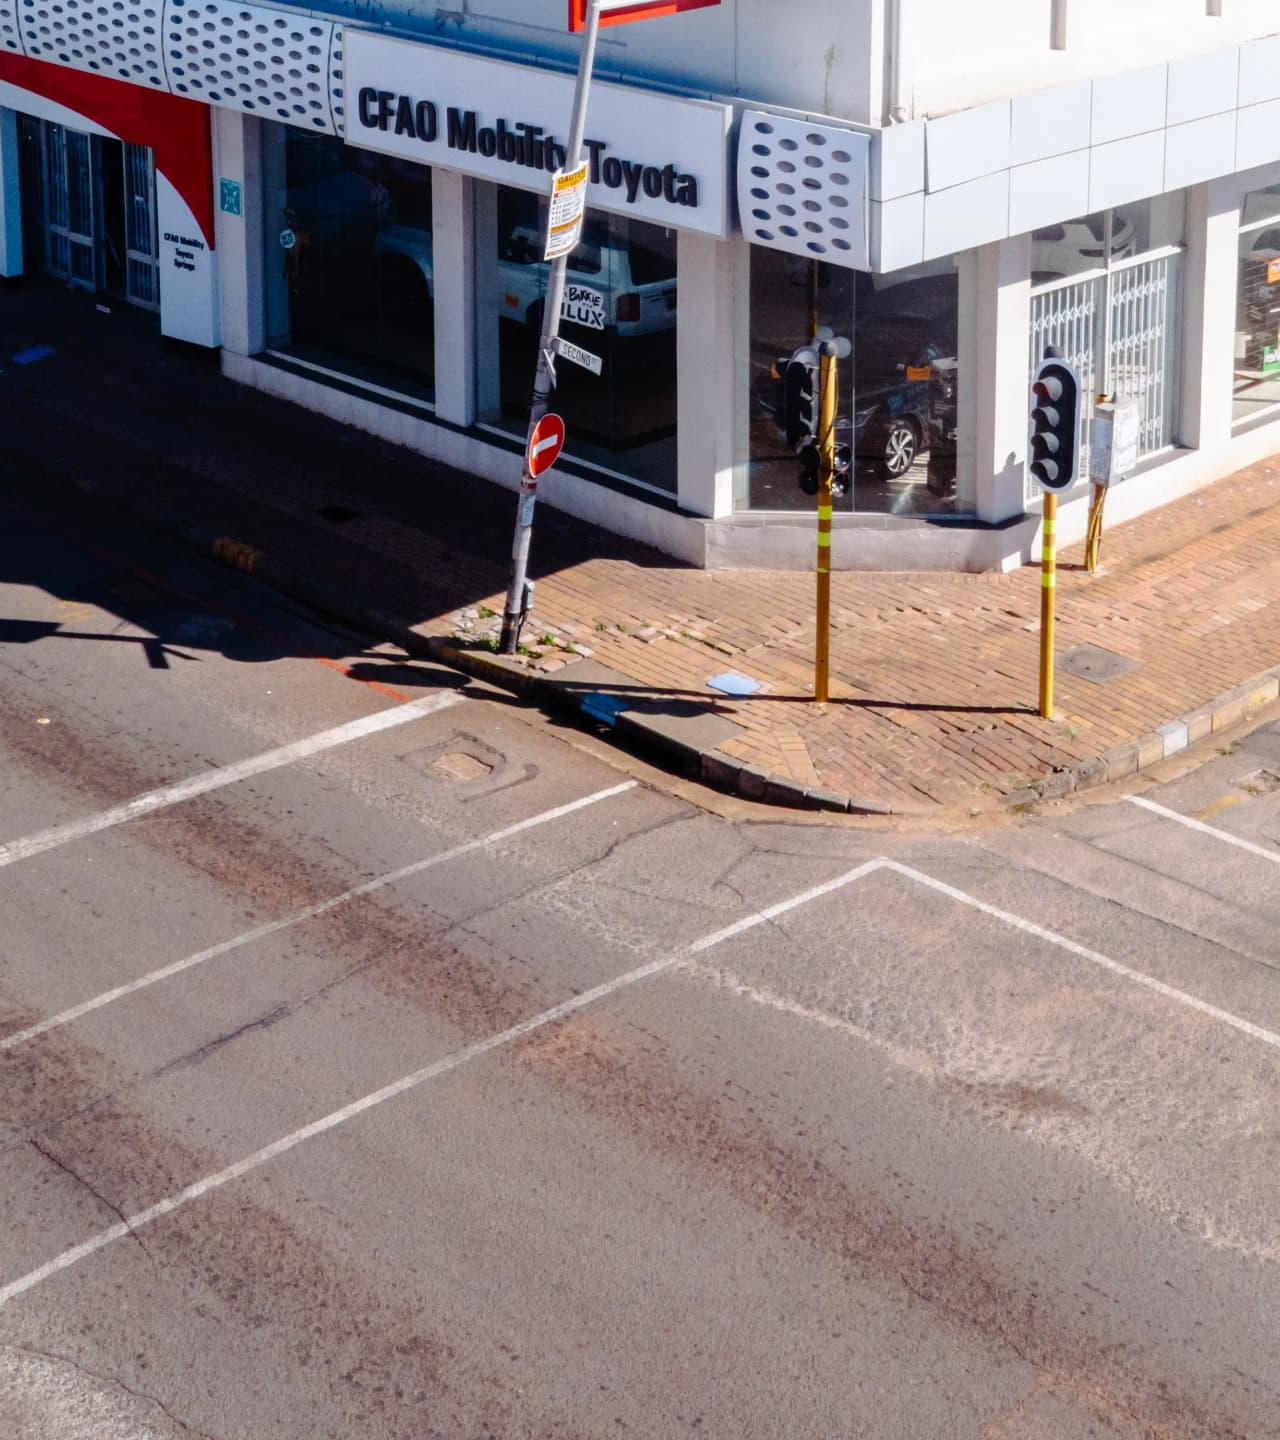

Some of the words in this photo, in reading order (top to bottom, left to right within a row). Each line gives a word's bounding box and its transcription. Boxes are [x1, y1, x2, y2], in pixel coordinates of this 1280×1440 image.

[359, 87, 437, 142] CFAO
[583, 139, 697, 208] Toyota
[560, 302, 603, 327] ILUX
[562, 343, 591, 367] SECOND
